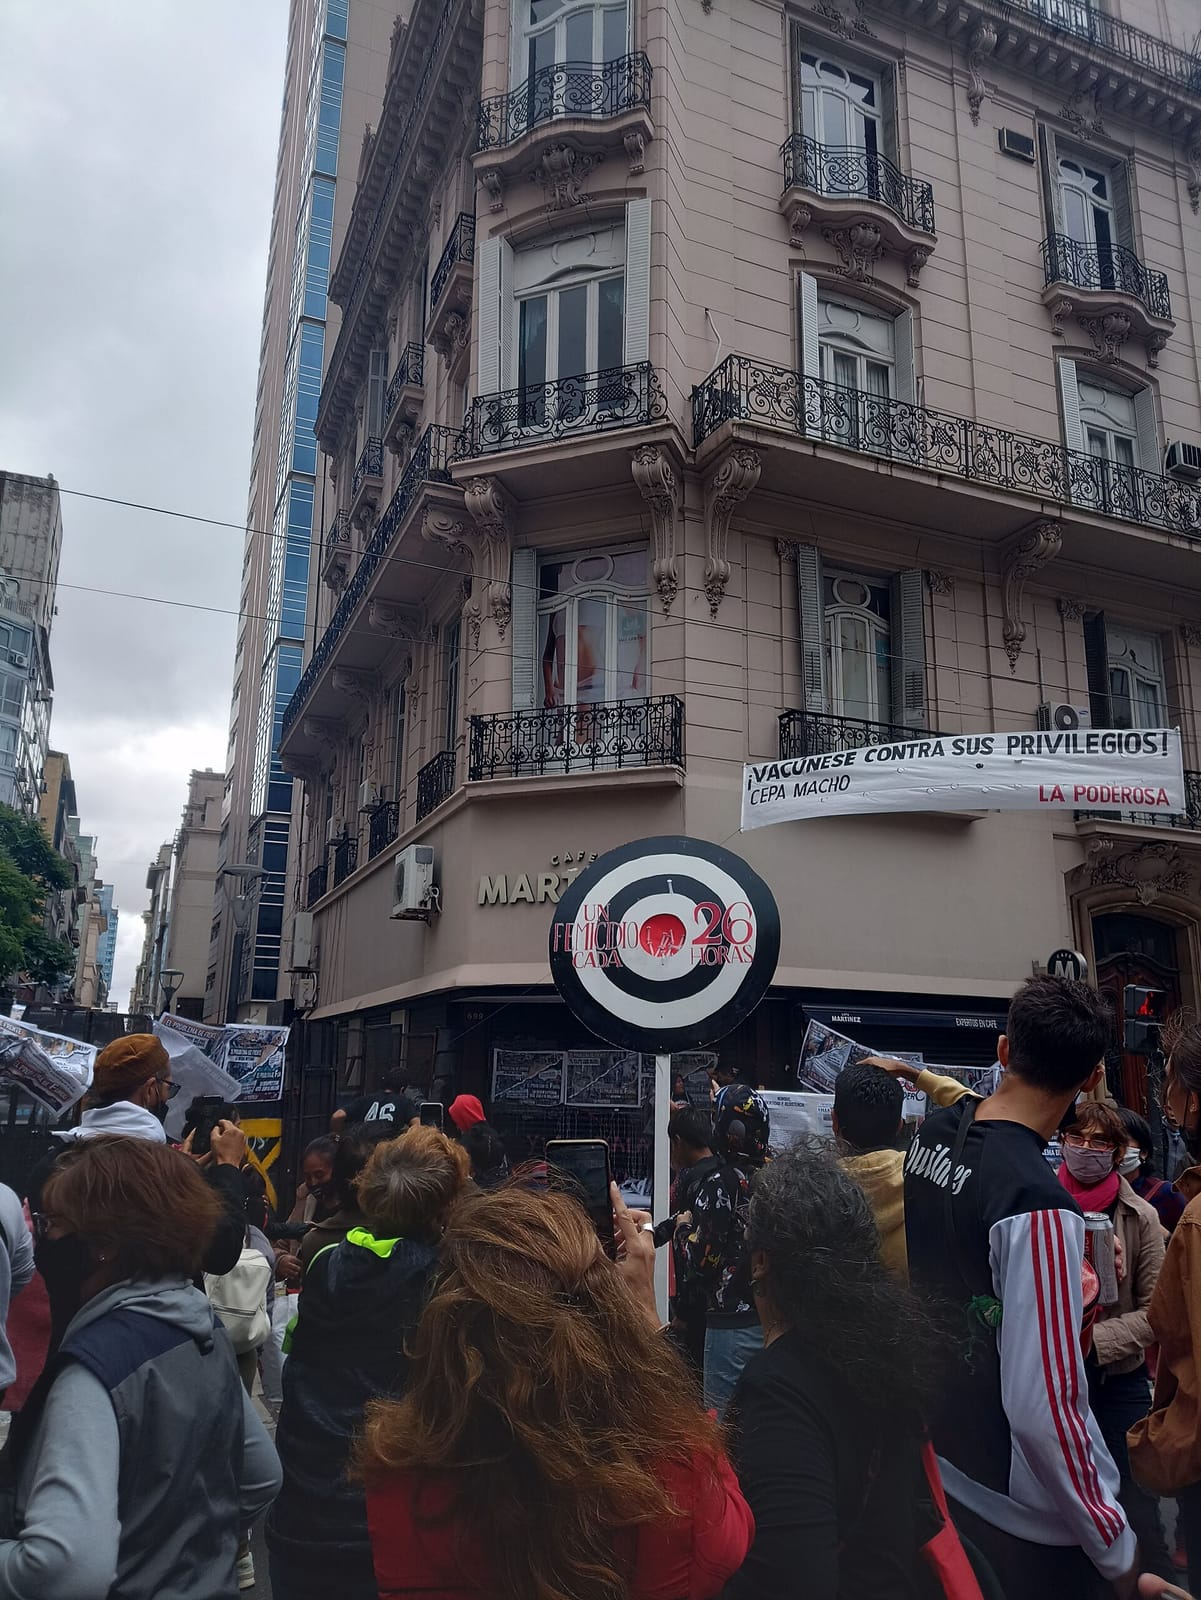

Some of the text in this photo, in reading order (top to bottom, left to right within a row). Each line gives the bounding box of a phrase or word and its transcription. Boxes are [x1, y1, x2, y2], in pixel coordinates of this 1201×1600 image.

[747, 731, 1169, 792] ¡VACÚNESE CONTRA SUS PRIVILEGIOS!
[750, 774, 851, 806] CEPA MACHO
[1039, 784, 1170, 807] LA PODEROSA
[584, 903, 611, 922] UN
[691, 901, 754, 946] 26
[553, 921, 639, 952] FEMICIDIO
[572, 951, 623, 969] CADA
[689, 945, 754, 966] HORAS
